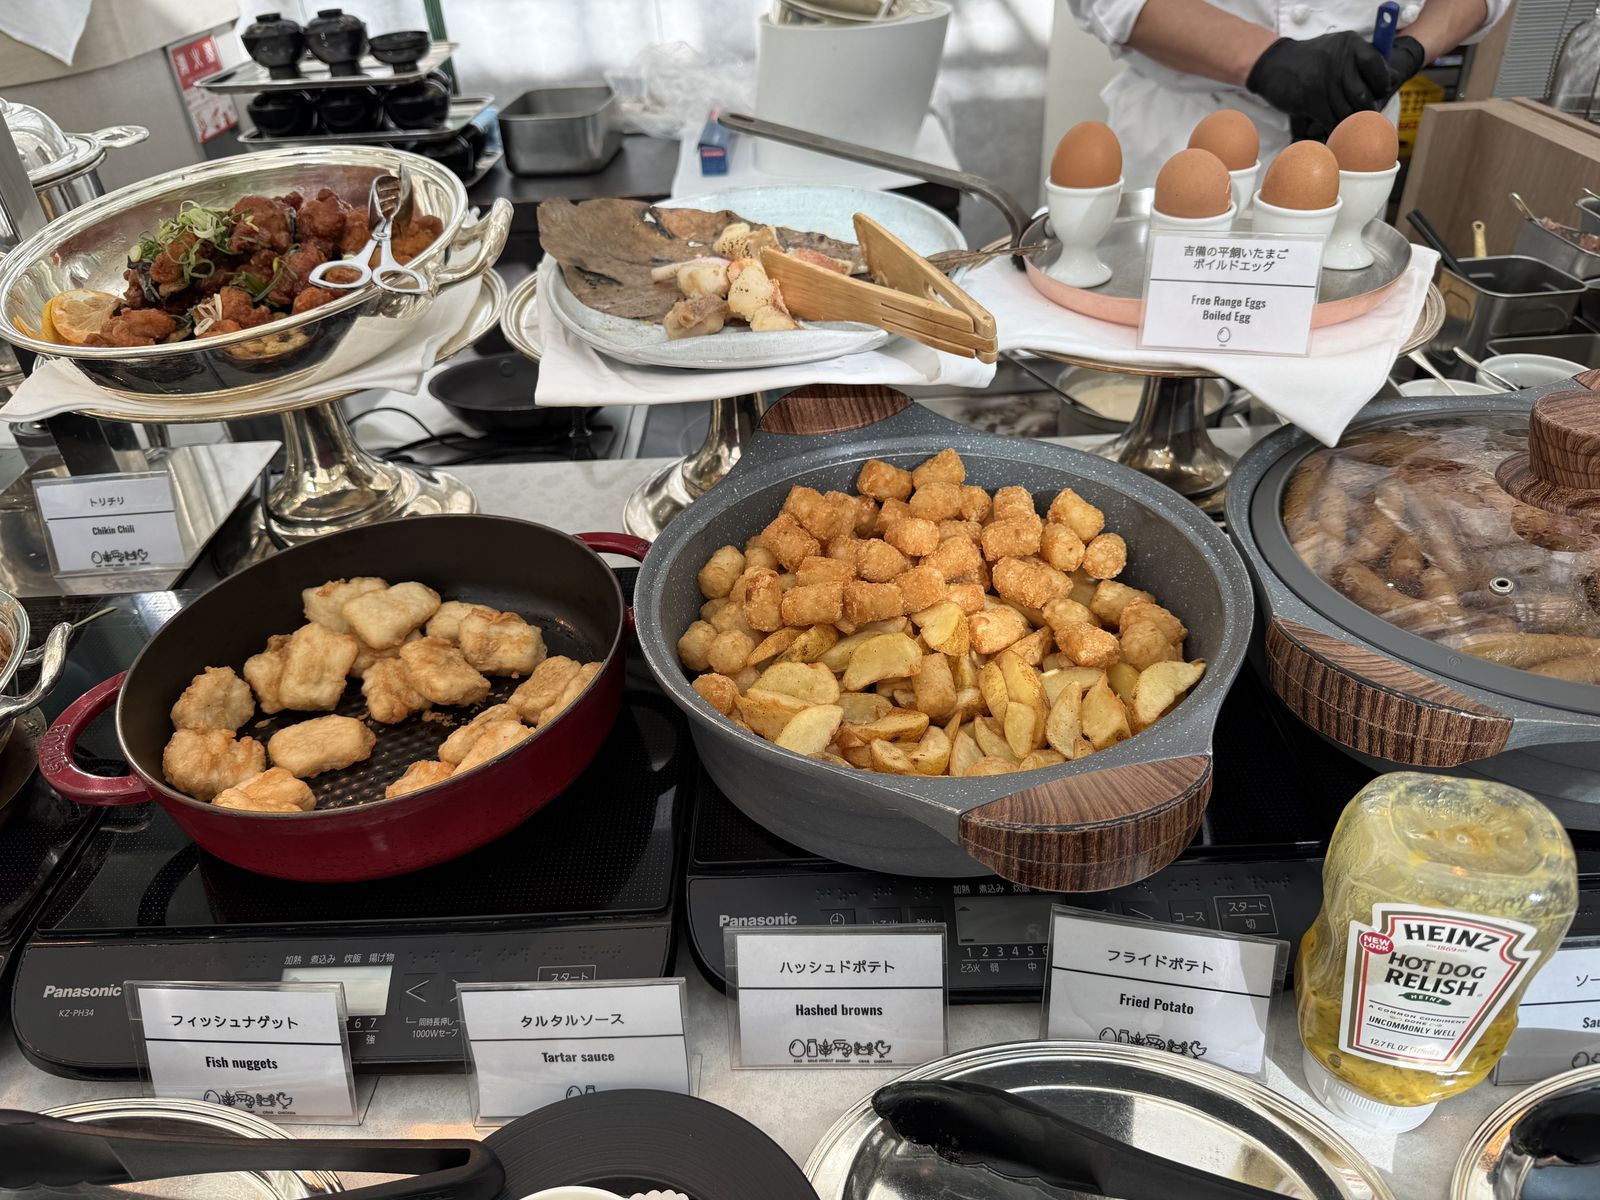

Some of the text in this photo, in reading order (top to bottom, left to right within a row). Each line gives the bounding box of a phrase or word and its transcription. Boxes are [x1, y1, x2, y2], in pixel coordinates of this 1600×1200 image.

[1184, 245, 1289, 260] 吉備の平飼いたまご
[1193, 259, 1275, 272] ボイルドエッグ
[1191, 295, 1266, 310] Free Range Eggs
[1202, 310, 1251, 325] Boiled Egg
[89, 496, 125, 508] トリチリ
[92, 525, 135, 536] Chikin Chili
[1228, 901, 1267, 912] スタート
[719, 913, 798, 927] Panasonic
[1174, 912, 1205, 922] コース
[1246, 918, 1256, 930] 切
[1363, 934, 1391, 946] NEW
[1403, 923, 1500, 952] HEINZ
[966, 947, 972, 958] 1
[982, 946, 989, 957] 2
[997, 946, 1004, 957] 3
[1011, 946, 1019, 956] 4
[1027, 945, 1034, 956] 5
[1363, 942, 1389, 952] LOOK
[285, 952, 395, 965] 加熱 煮込み 炊飯 揚げ物
[1107, 949, 1215, 974] フライドポテト
[780, 959, 896, 975] ハッシュドポテト
[1028, 962, 1037, 972] 中
[1388, 952, 1488, 979] HOT DOG
[551, 972, 589, 981] スタート
[1384, 968, 1479, 997] RELISH
[43, 983, 122, 999] Panasonic
[1119, 993, 1194, 1015] Fried Potato
[1410, 994, 1443, 1004] HEINZ
[58, 1008, 95, 1018] KZ-PH34
[795, 1004, 883, 1016] Hashed browns
[1377, 1007, 1417, 1019] COMMON
[1419, 1016, 1467, 1025] CONDIMENT
[170, 1014, 299, 1030] フィッシュナゲット
[354, 1018, 377, 1029] 6 7
[520, 1012, 625, 1029] タルタルソース
[1368, 1015, 1457, 1037] UNCOMMONLY WELL
[365, 1034, 376, 1045] 強
[1370, 1038, 1386, 1047] 12.7
[1386, 1042, 1396, 1050] FL
[205, 1055, 278, 1072] Fish nuggets
[541, 1051, 616, 1064] Tartar sauce
